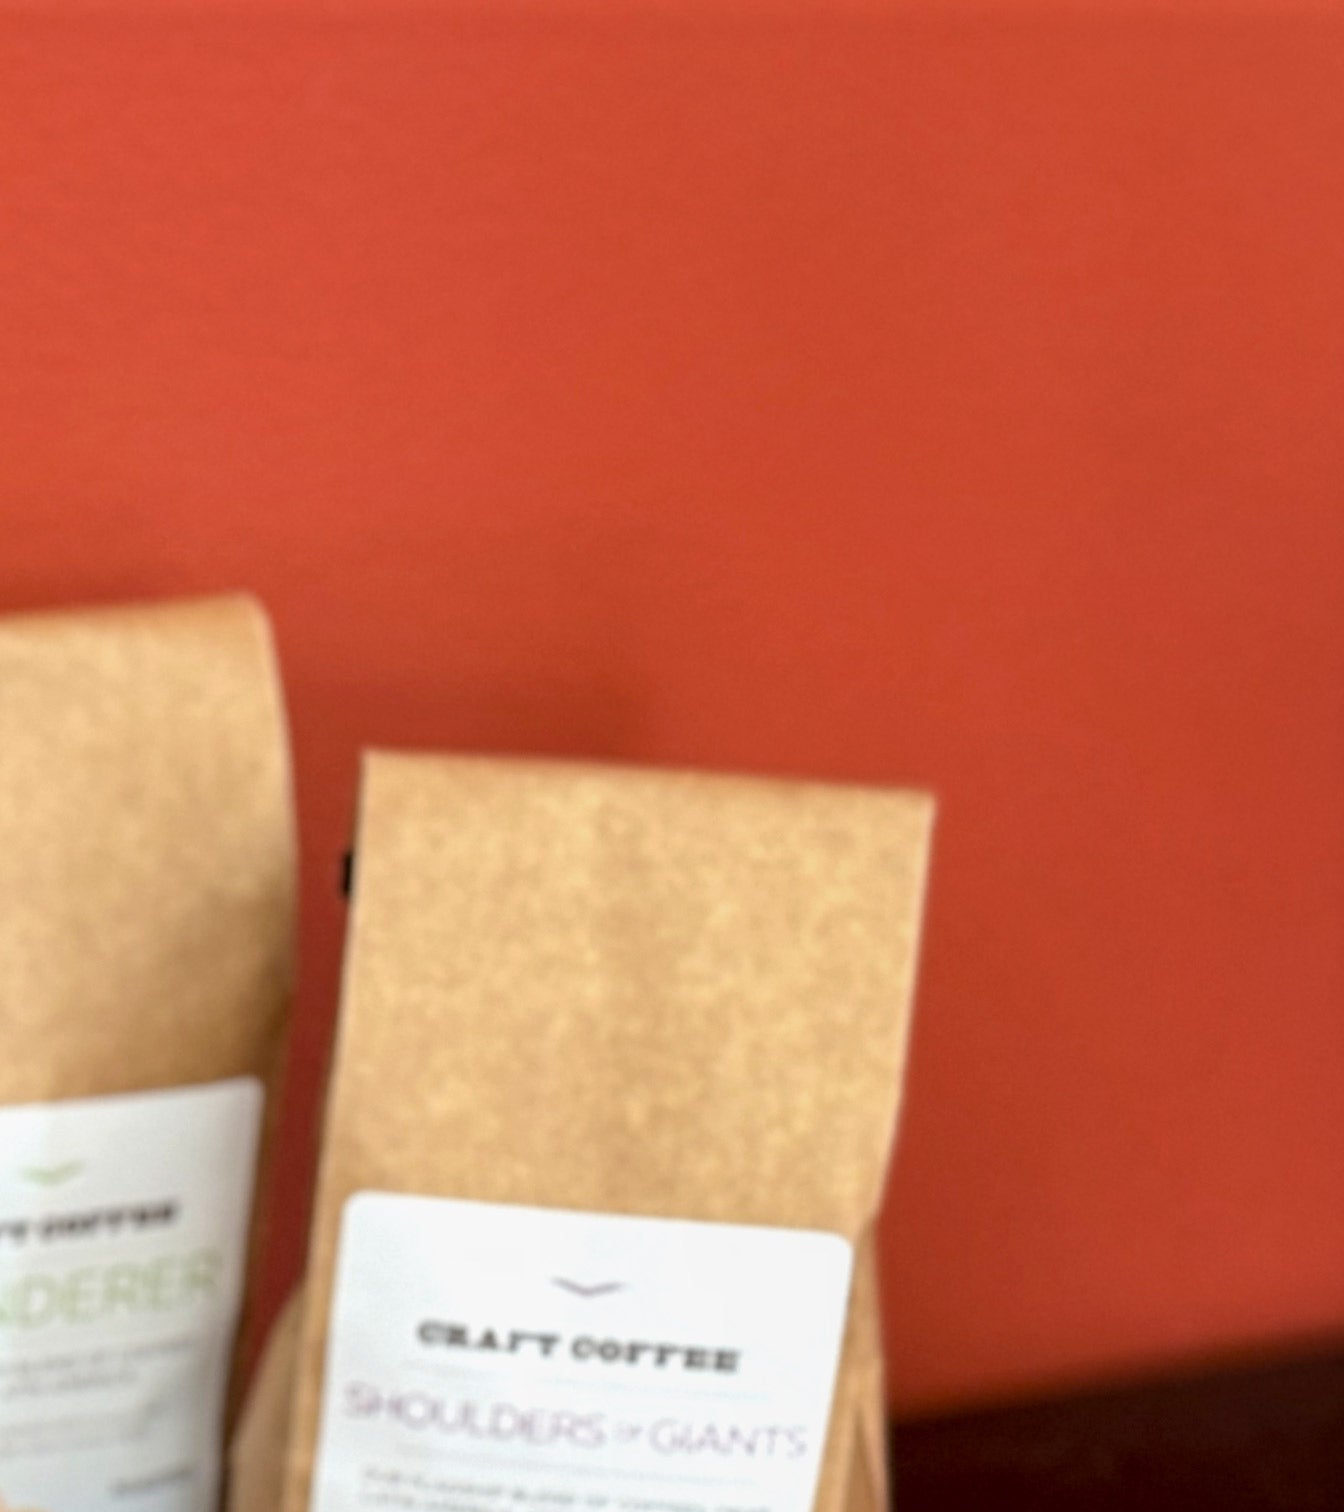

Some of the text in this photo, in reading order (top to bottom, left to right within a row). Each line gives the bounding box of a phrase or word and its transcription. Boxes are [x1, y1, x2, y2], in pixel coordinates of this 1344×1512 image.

[417, 1318, 743, 1376] CRAFT COFFEE
[341, 1378, 606, 1450] SHOULDERS
[649, 1416, 810, 1461] GIANTS
